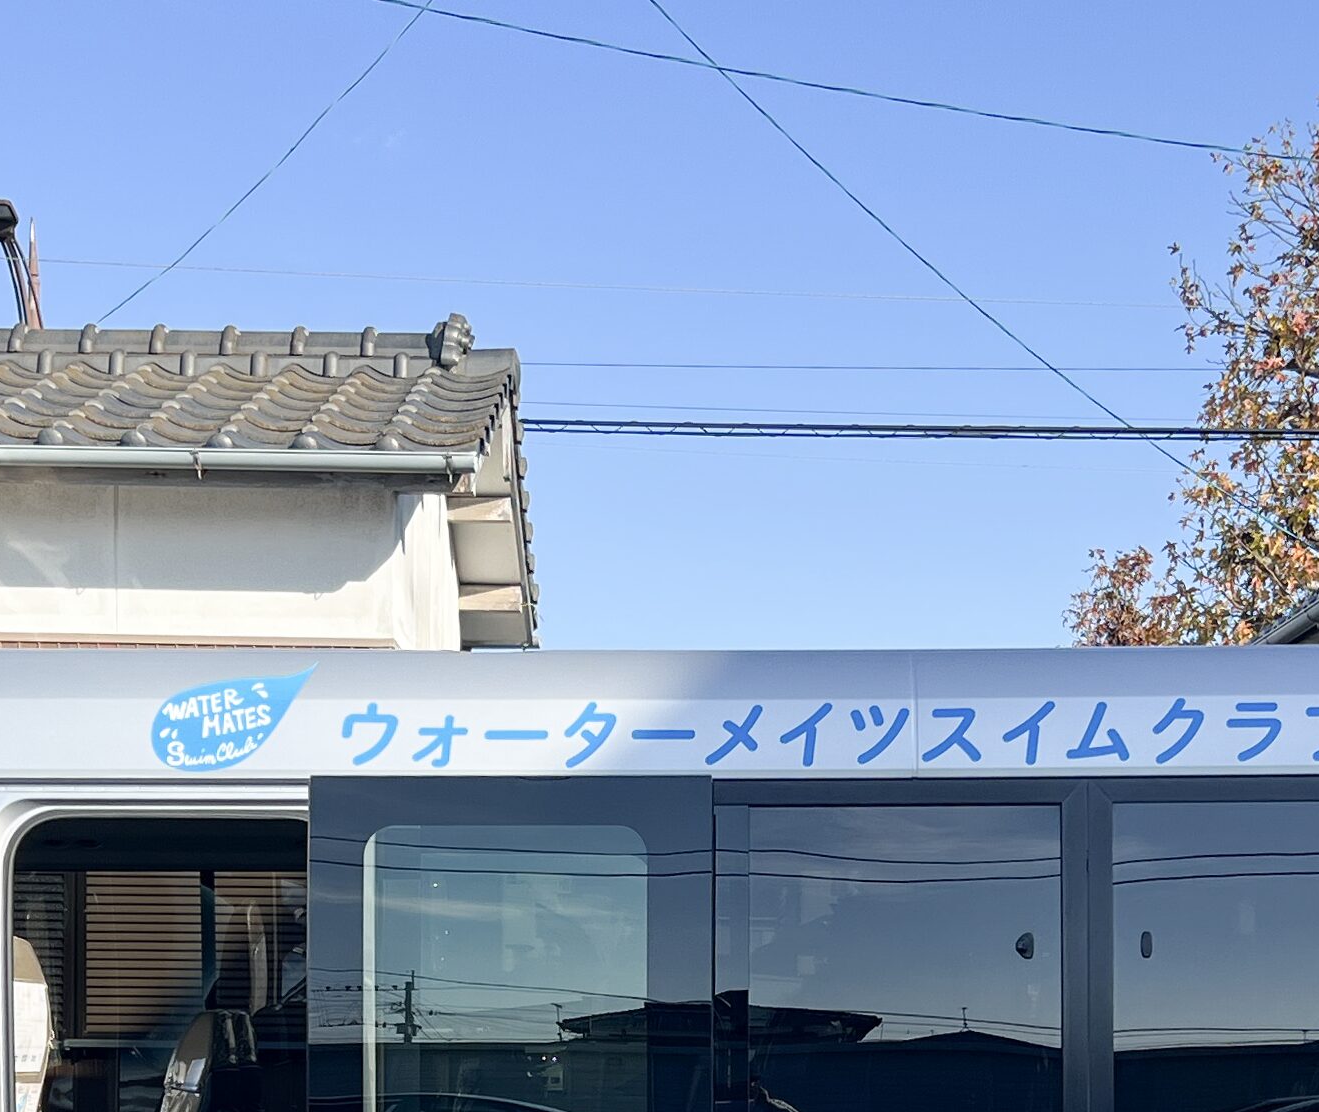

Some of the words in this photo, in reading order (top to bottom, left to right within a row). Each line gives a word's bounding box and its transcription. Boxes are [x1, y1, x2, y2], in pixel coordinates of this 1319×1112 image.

[162, 688, 244, 721] WATER
[202, 704, 272, 739] MATES
[166, 741, 216, 767] Swim
